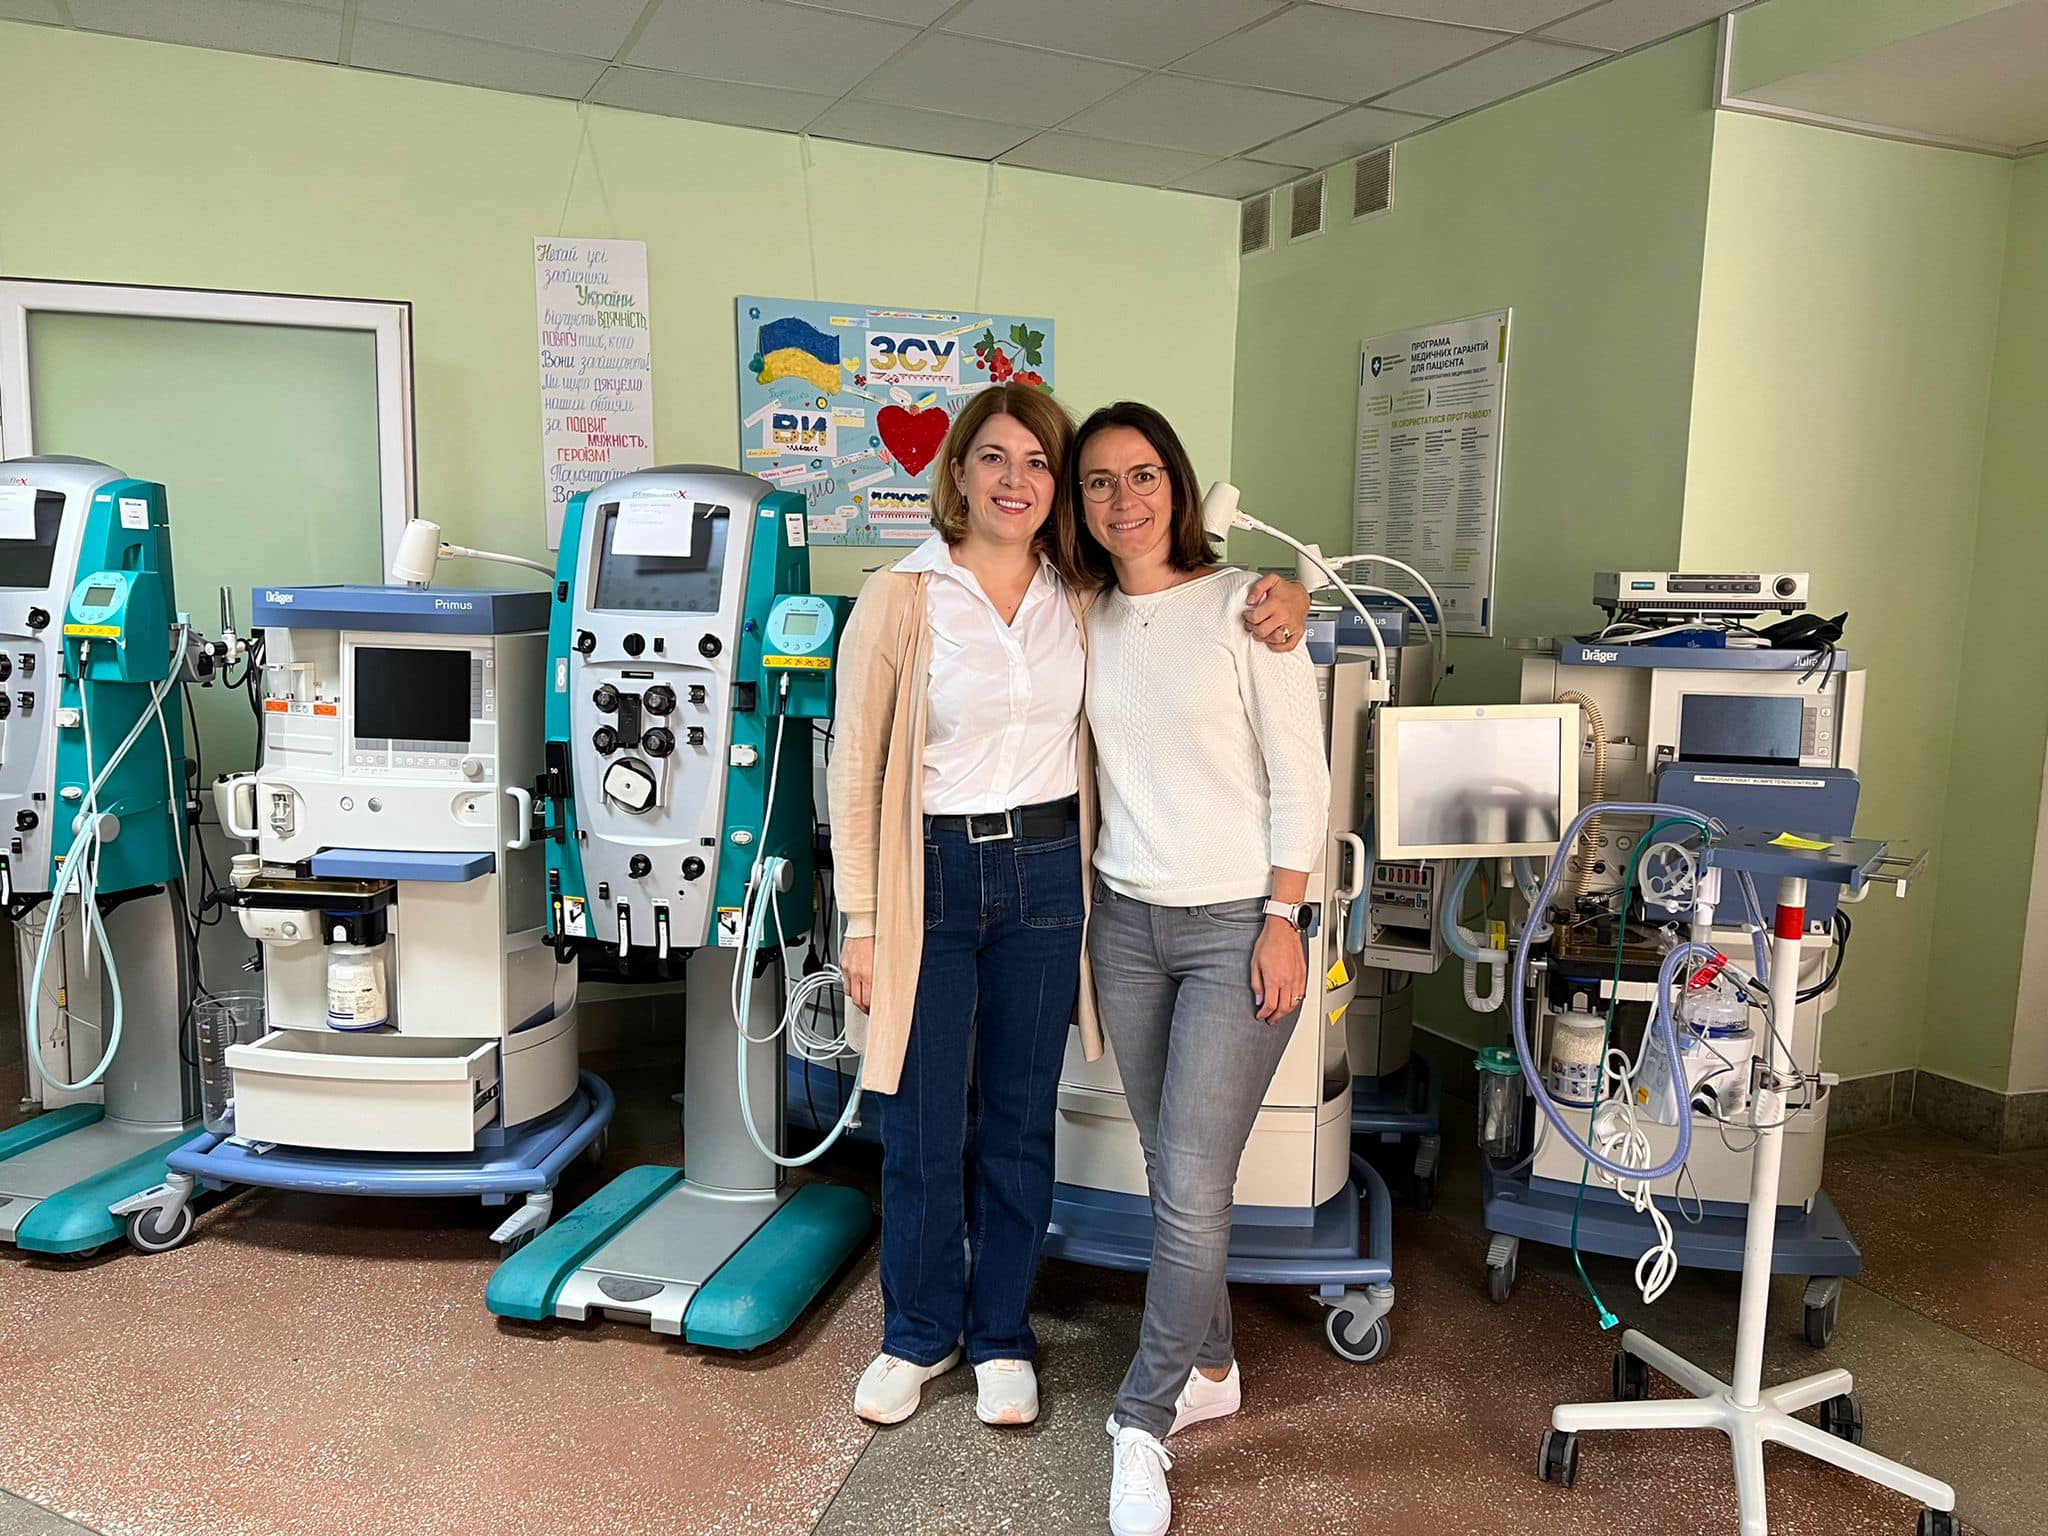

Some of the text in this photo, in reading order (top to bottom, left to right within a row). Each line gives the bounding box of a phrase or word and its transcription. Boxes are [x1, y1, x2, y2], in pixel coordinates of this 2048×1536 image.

[536, 243, 578, 262] Нехай
[575, 284, 636, 308] України
[542, 330, 577, 347] ПОВАГУ
[1411, 337, 1450, 351] ПРОГРАМА
[541, 350, 576, 368] Вони
[870, 336, 955, 372] ЗСУ
[1411, 340, 1489, 362] МЕДИЧНИХ ГАРАНТІЙ
[1410, 358, 1464, 375] ДЛЯ ПАЦІЄНТА
[545, 418, 561, 435] за
[772, 413, 826, 446] ВИ
[557, 447, 611, 463] ГЕРОЇЗМ!
[265, 591, 294, 605] Dräger
[435, 599, 473, 610] Primus
[1582, 648, 1619, 664] Dräger
